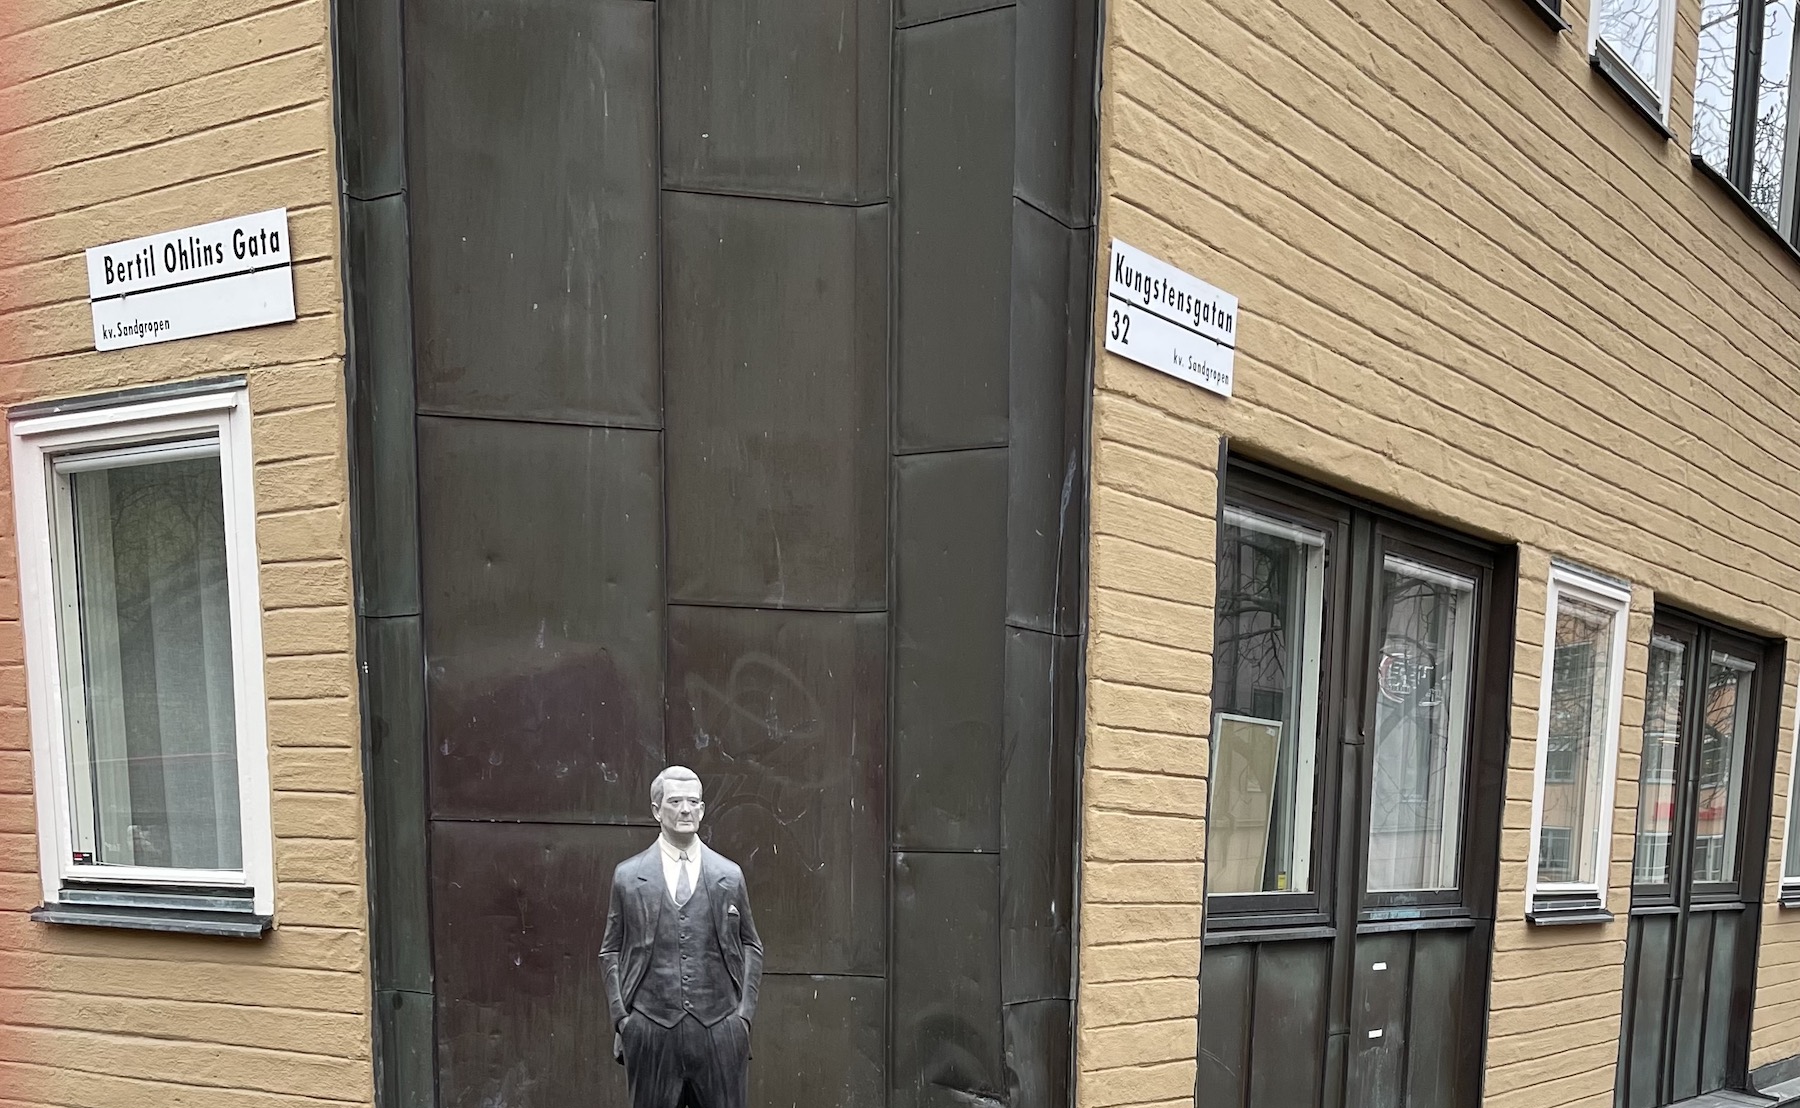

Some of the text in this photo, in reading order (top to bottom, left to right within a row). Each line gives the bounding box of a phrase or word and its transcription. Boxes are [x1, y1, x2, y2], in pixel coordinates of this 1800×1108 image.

[104, 228, 280, 285] Bertil Ohlins Gata
[1115, 252, 1233, 333] Kungstensgatan
[1111, 310, 1131, 345] 32
[1188, 355, 1229, 386] Sandgropen
